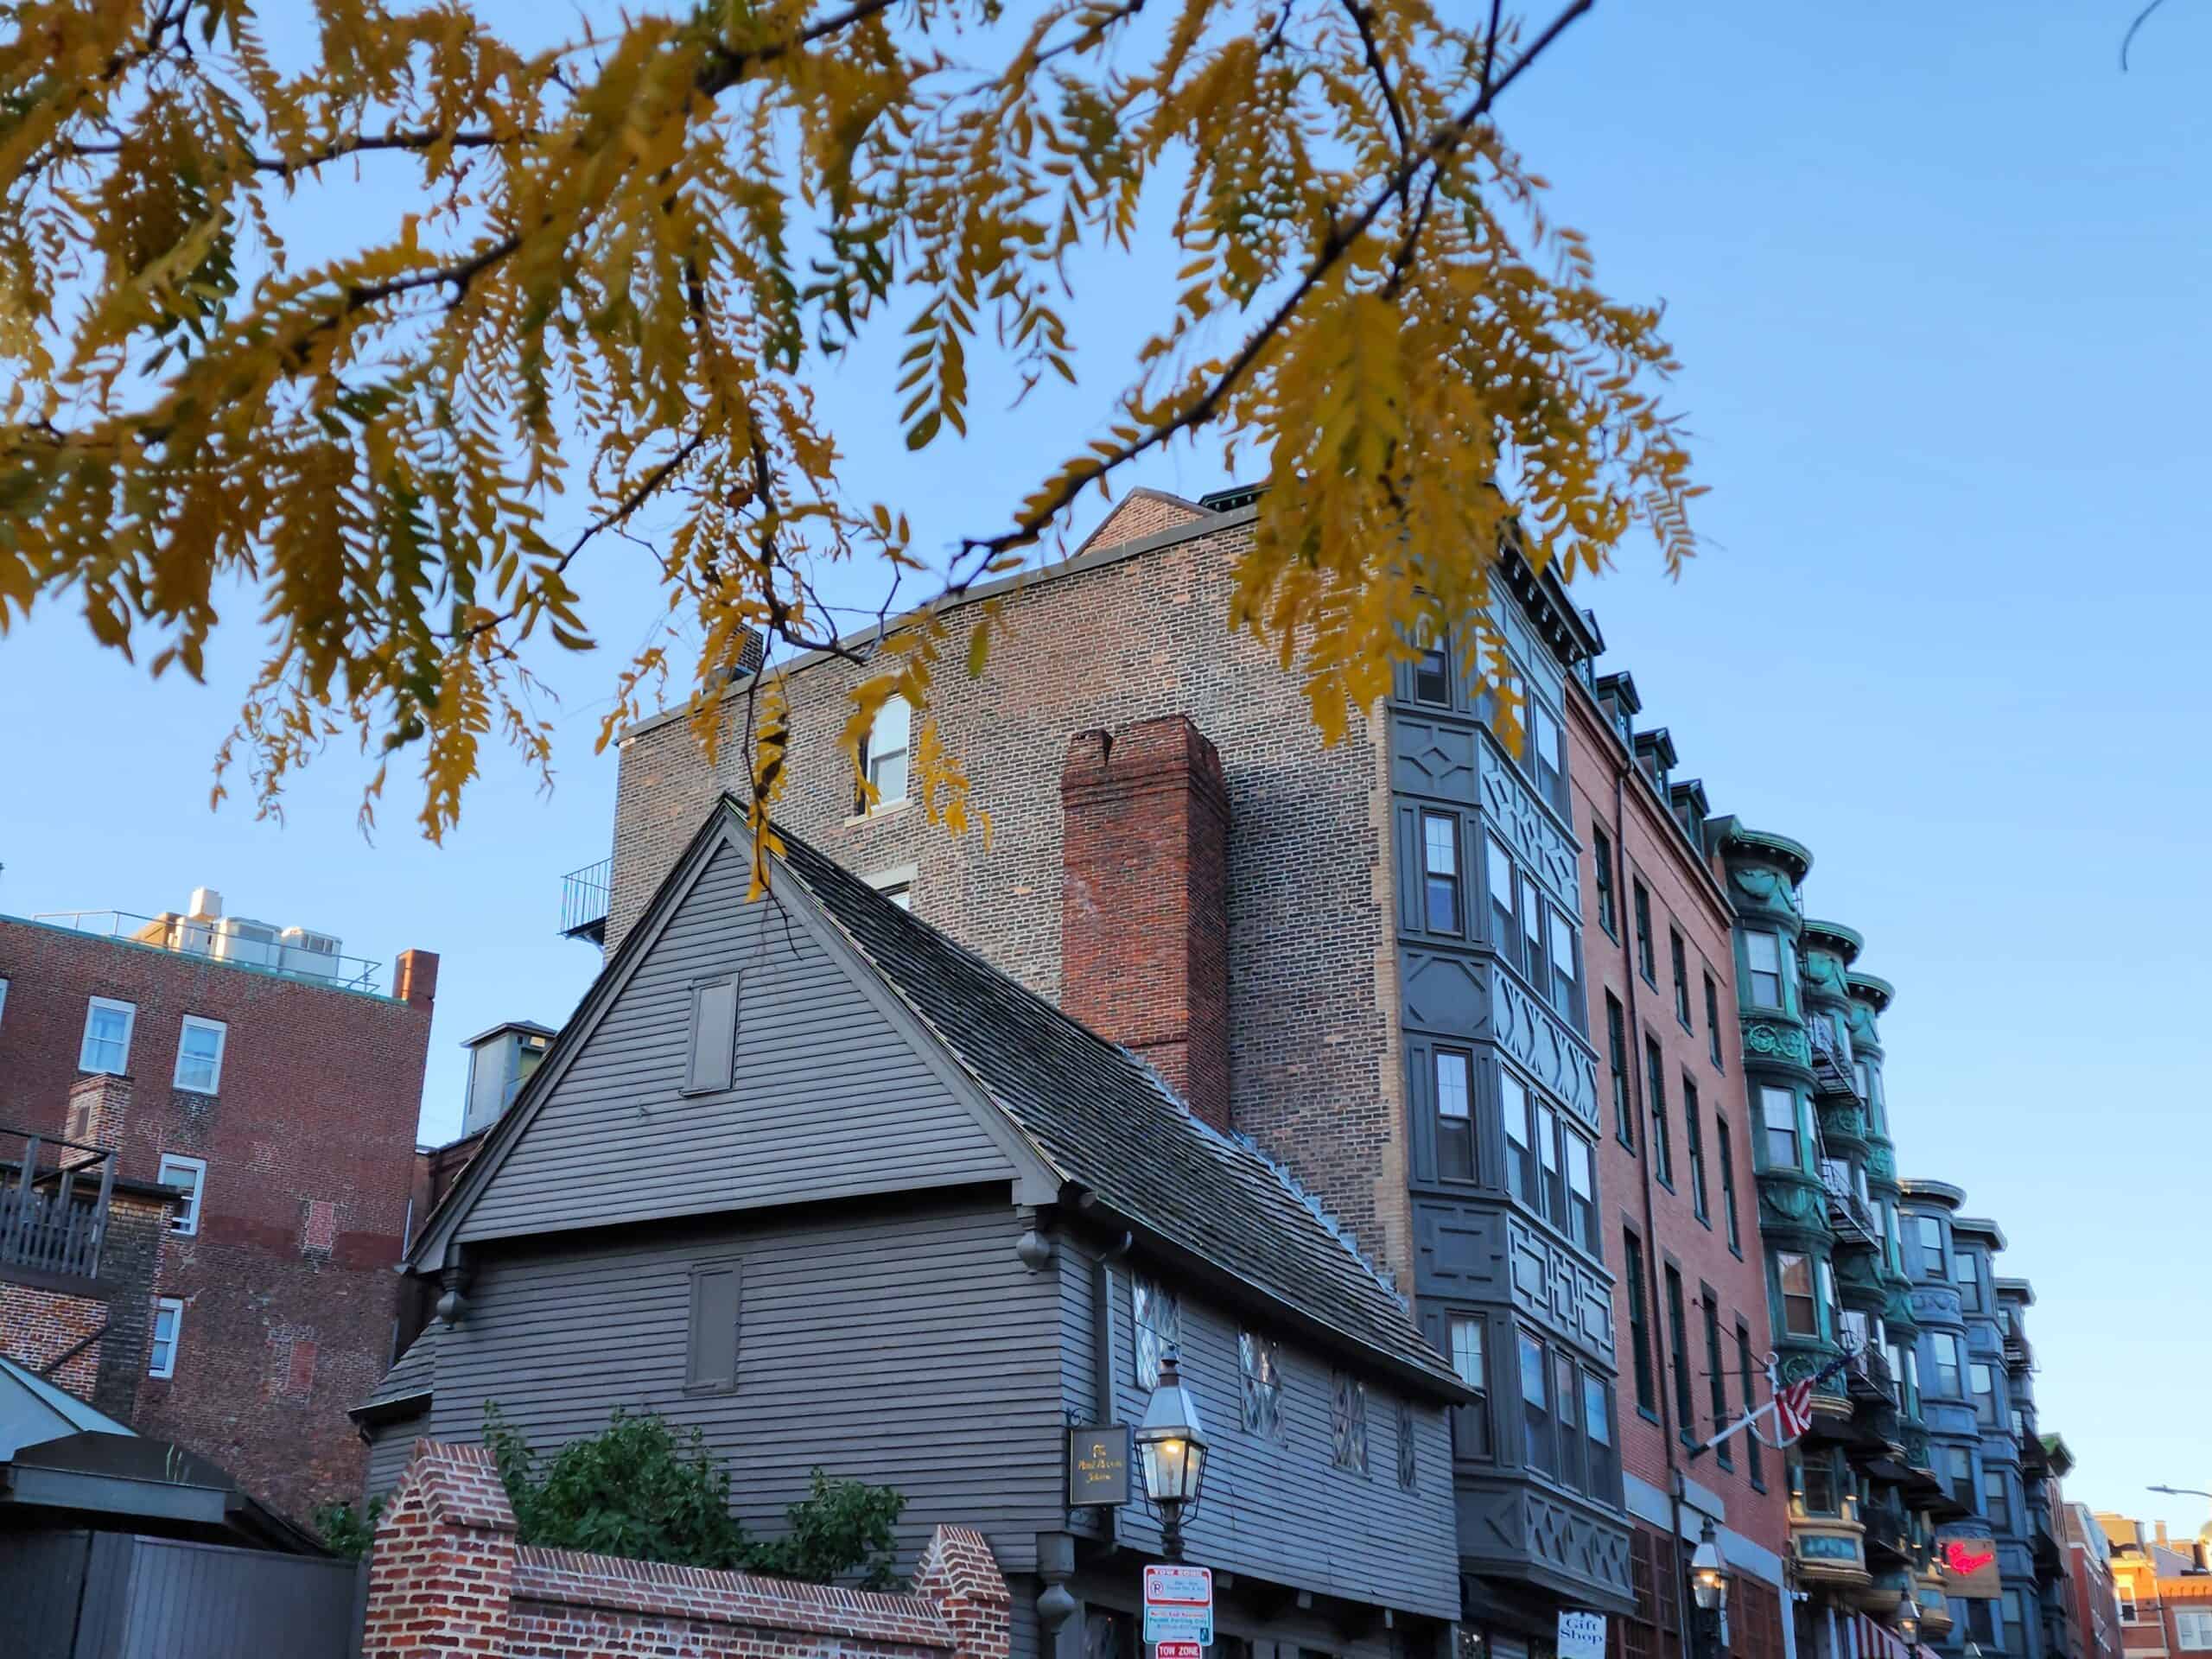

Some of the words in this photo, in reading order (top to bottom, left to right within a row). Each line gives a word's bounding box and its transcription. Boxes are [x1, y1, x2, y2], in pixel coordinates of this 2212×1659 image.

[1567, 1618, 1597, 1630] Gift
[1560, 1630, 1603, 1645] Shop
[1159, 1646, 1175, 1656] TOW
[1178, 1646, 1199, 1656] ZONE
